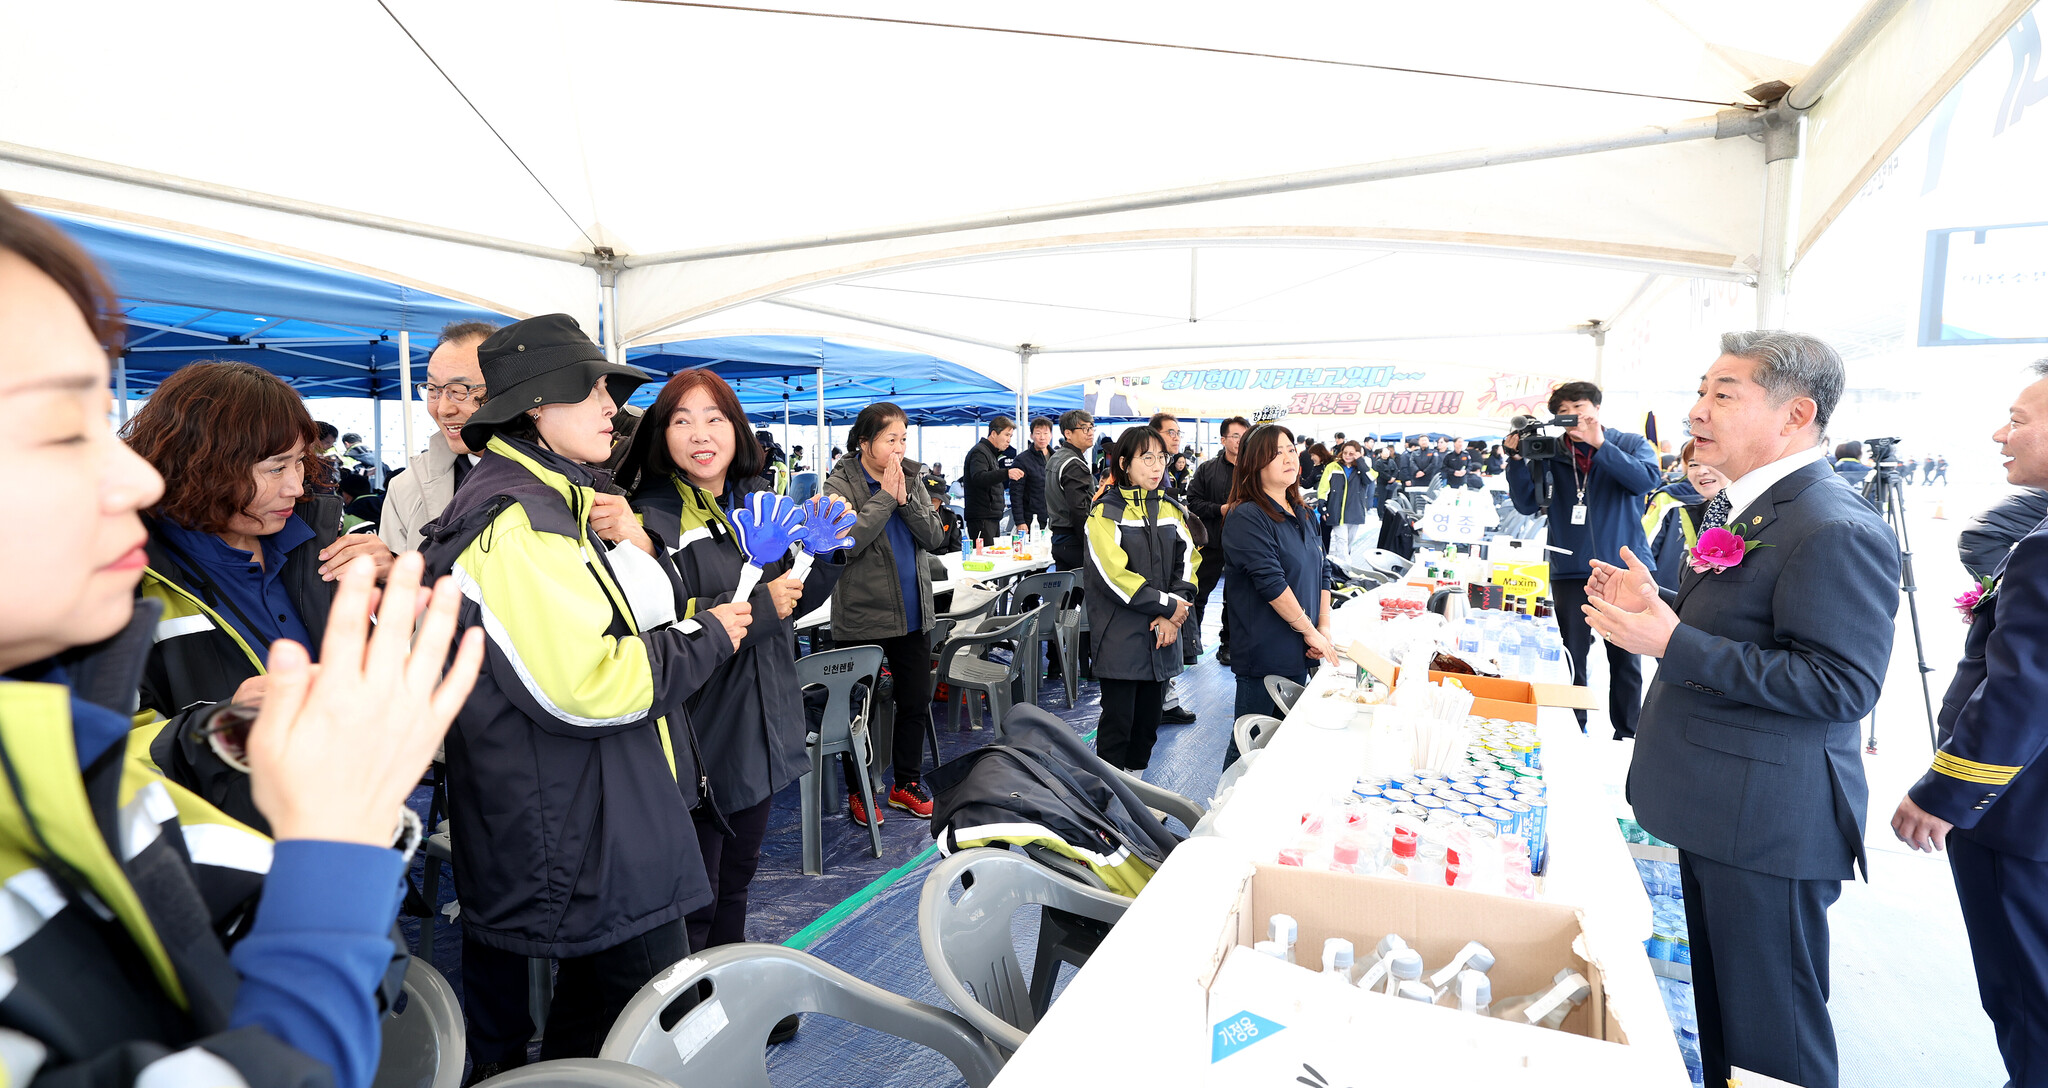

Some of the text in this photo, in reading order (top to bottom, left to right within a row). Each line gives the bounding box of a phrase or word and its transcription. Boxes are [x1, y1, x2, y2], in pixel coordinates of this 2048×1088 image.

[1161, 369, 1250, 390] 상기형이
[1287, 392, 1361, 414] 최선을
[1503, 577, 1537, 588] Maxim
[823, 661, 855, 676] 인천렌탈
[1218, 1016, 1259, 1046] 가정용
